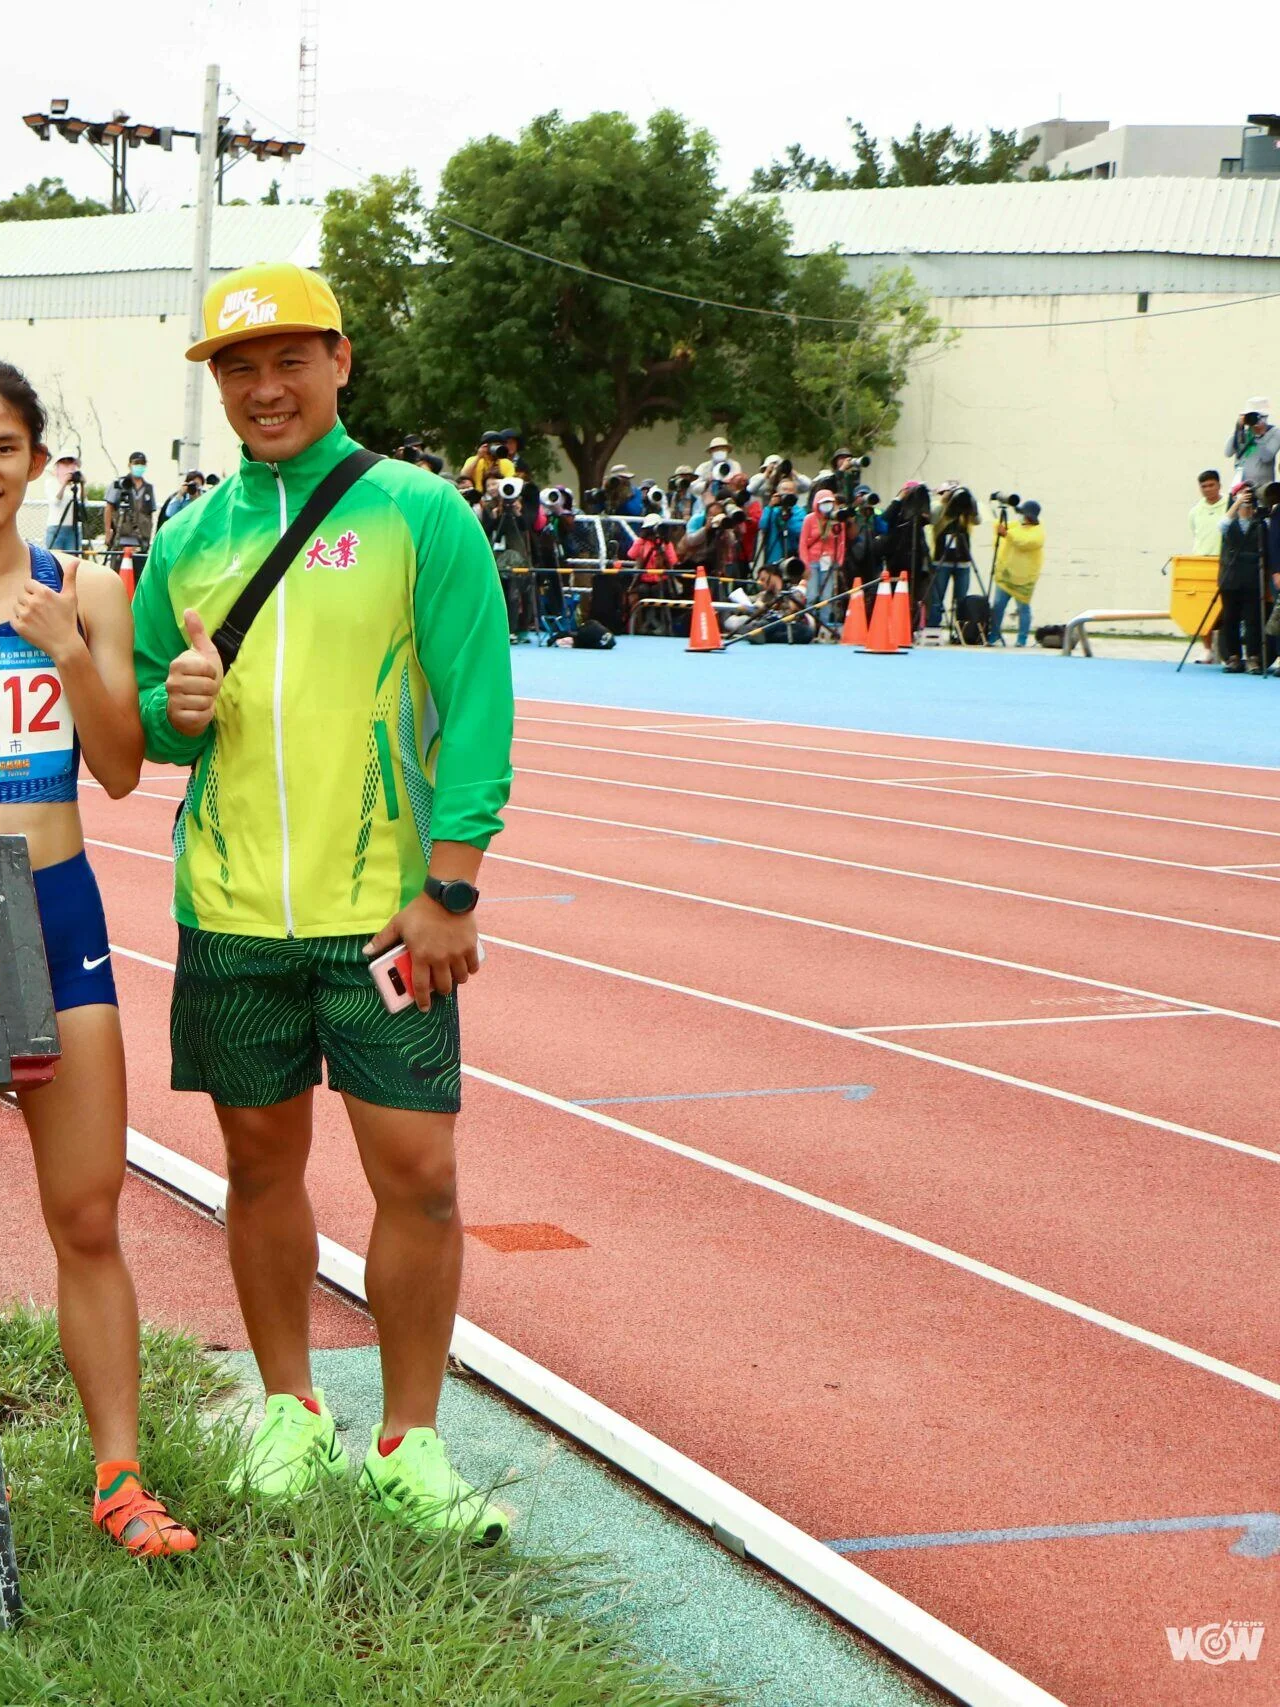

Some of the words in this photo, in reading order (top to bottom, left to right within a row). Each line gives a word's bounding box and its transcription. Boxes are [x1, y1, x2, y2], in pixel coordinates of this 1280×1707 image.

[223, 288, 257, 314] NIKE
[245, 302, 278, 327] AIR
[304, 529, 360, 570] 大業
